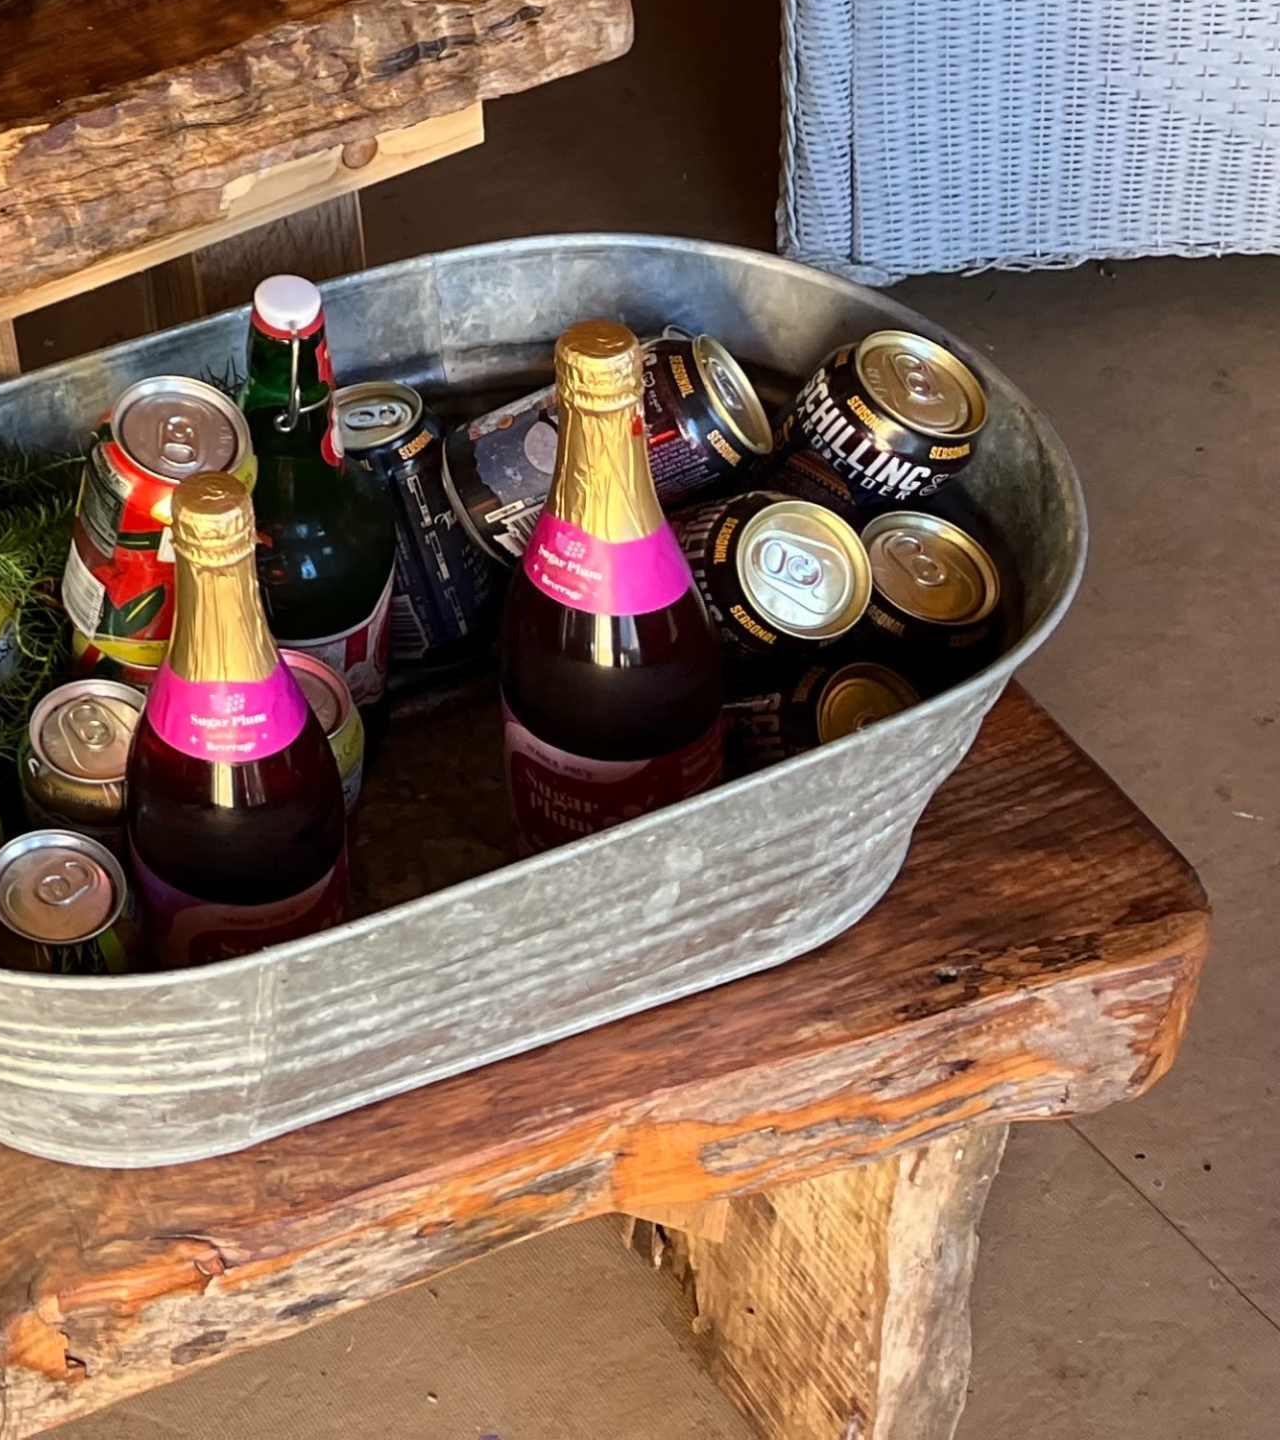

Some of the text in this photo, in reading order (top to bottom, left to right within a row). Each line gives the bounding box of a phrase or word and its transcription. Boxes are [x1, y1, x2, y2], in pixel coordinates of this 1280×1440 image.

[804, 368, 931, 495] SCHILLING
[730, 604, 777, 644] SEASONAL
[190, 713, 267, 729] Sugar Plum
